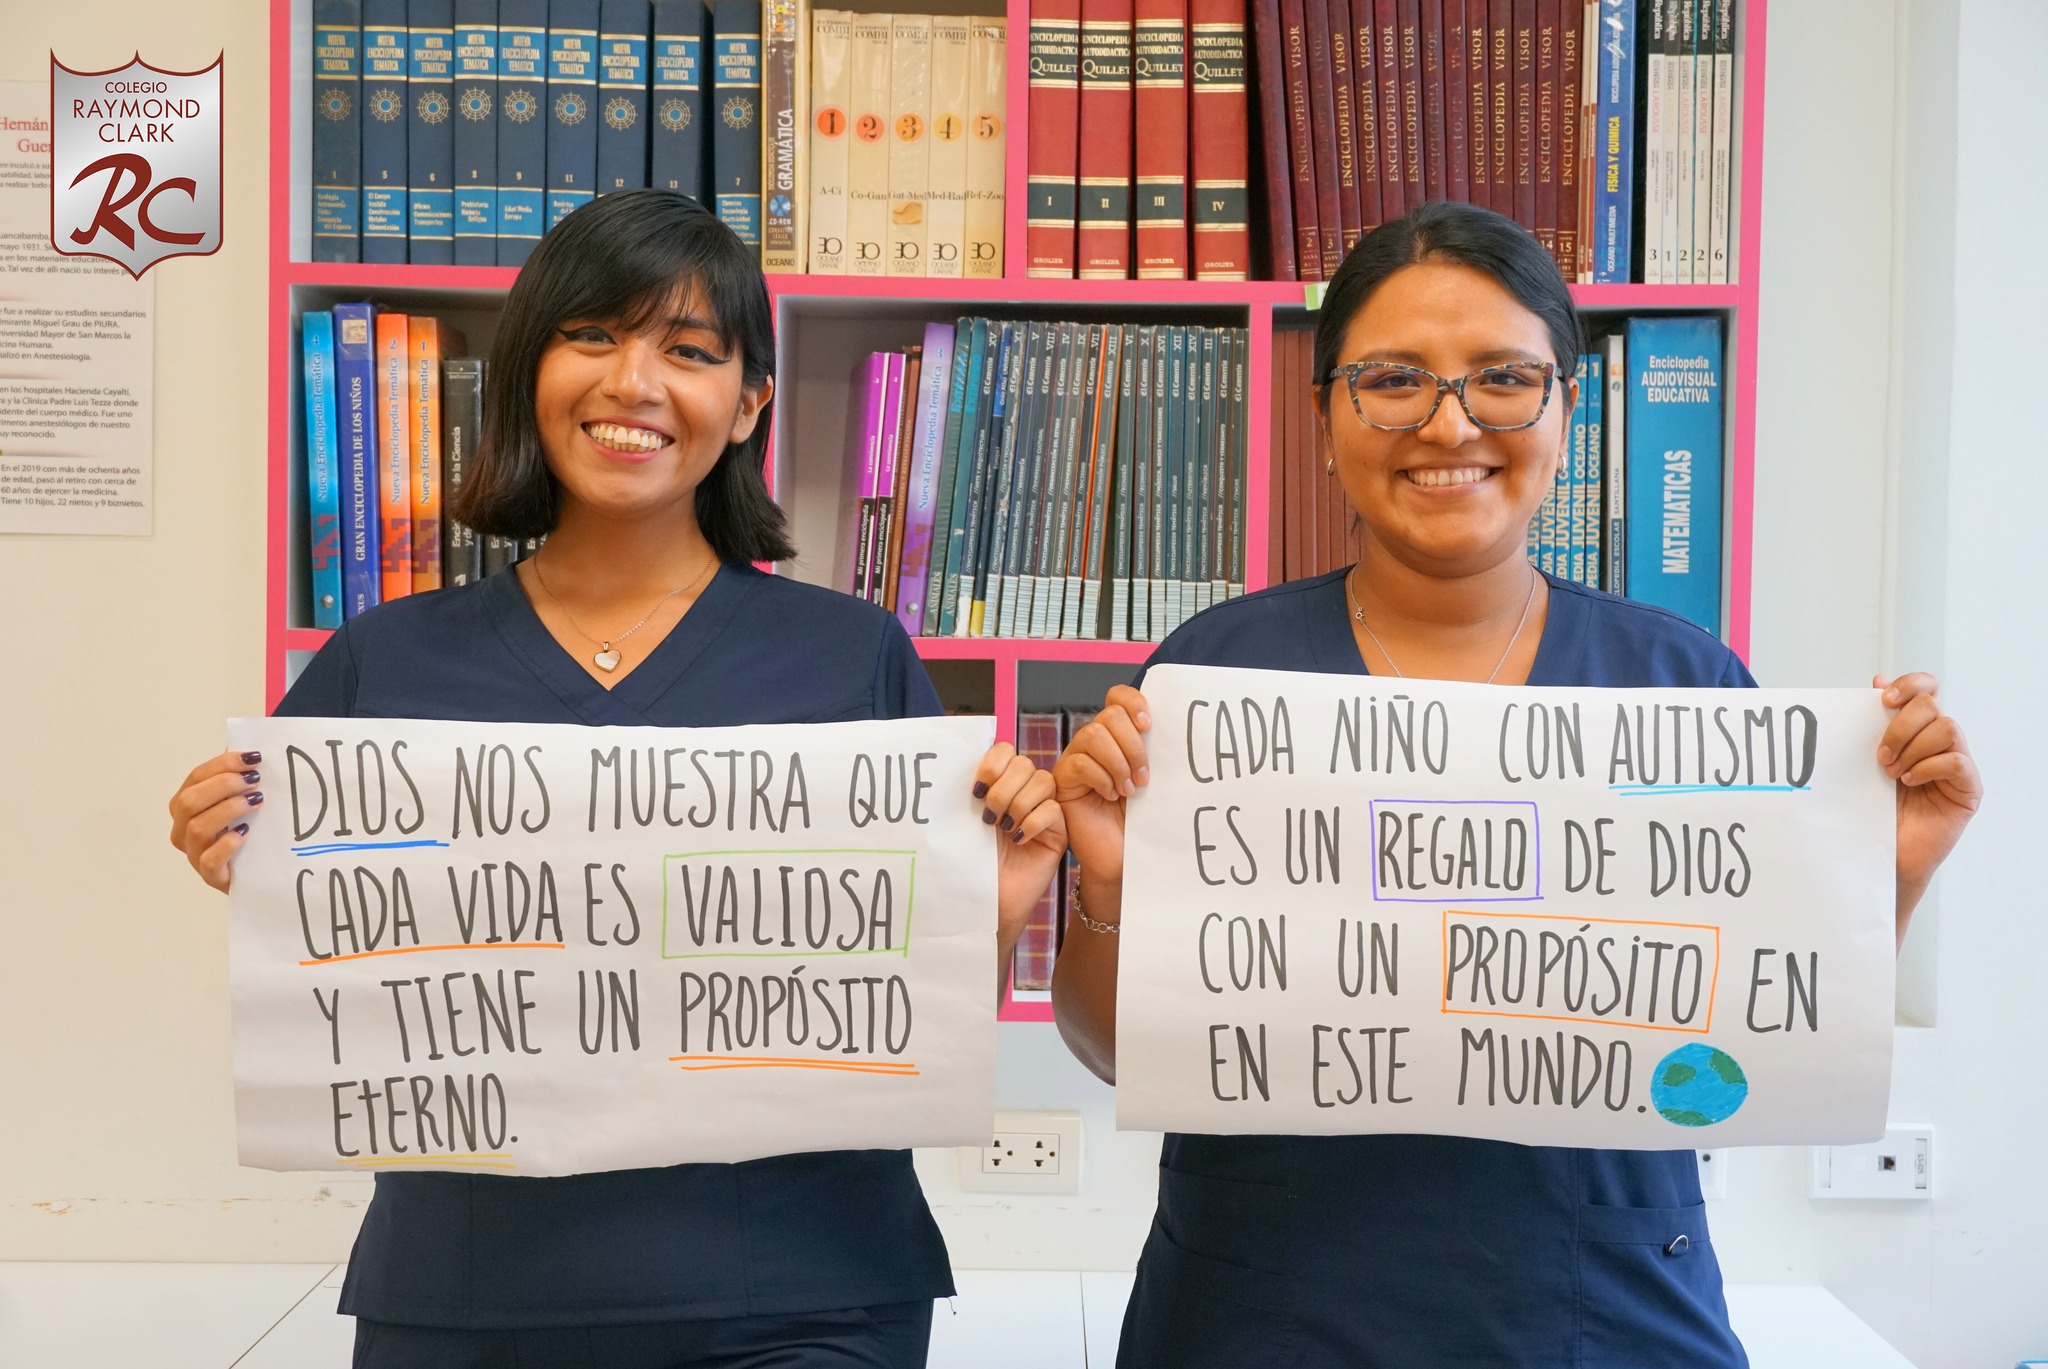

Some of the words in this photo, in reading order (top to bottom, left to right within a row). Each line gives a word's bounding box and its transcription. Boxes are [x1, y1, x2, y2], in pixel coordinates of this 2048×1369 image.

[378, 36, 396, 46] NUEVA
[468, 34, 485, 45] NUEVA
[855, 30, 888, 39] COMBI
[934, 30, 966, 40] COMBI
[1031, 33, 1078, 42] ENCICLOPEDIA
[564, 39, 581, 49] NUEVA
[1194, 38, 1242, 47] ENCICLOPEDIA
[1384, 26, 1394, 68] VISOR
[1194, 50, 1243, 59] AUTODIDACTICA
[1565, 30, 1575, 72] VISOR
[827, 112, 836, 134] 1
[863, 116, 877, 139] 2
[902, 117, 917, 138] 3
[939, 117, 952, 139] 4
[980, 116, 994, 138] 5
[1386, 80, 1398, 182] ENCICLOPEDIA
[1563, 82, 1574, 186] ENCICLOPEDIA
[1608, 116, 1620, 154] QUIMICA
[778, 109, 793, 190] GRAMÁTICA
[333, 171, 337, 179] 1
[382, 171, 388, 179] 5
[430, 173, 435, 181] 6
[472, 170, 477, 178] 8
[516, 172, 522, 180] 9
[565, 174, 573, 182] 11
[1607, 164, 1619, 192] FISICA
[615, 179, 624, 187] 12
[669, 180, 678, 188] 13
[736, 178, 740, 186] 7
[1102, 198, 1109, 208] II
[1154, 196, 1164, 206] III
[1212, 202, 1224, 211] IV
[1560, 242, 1572, 253] 15
[1650, 250, 1657, 260] 3
[1697, 250, 1704, 260] 2
[1715, 250, 1722, 260] 6
[767, 258, 794, 266] OCEANO
[1666, 251, 1670, 261] 1
[1680, 250, 1687, 261] 2
[25, 308, 52, 316] realizar
[65, 309, 98, 317] estudios
[100, 310, 146, 318] secundarios
[390, 340, 396, 349] 2
[422, 341, 426, 350] 1
[989, 333, 997, 347] XV
[1126, 335, 1134, 345] VI
[1158, 335, 1166, 352] XVI
[936, 348, 943, 358] 3
[1592, 362, 1599, 377] 1
[1650, 355, 1708, 371] Enciclopedia
[388, 358, 398, 402] Temática
[419, 359, 428, 403] Temática
[1641, 372, 1716, 386] AUDIOVISUAL
[350, 377, 362, 410] NIÑOS
[929, 366, 942, 409] Temática
[1648, 388, 1710, 403] EDUCATIVA
[353, 413, 362, 433] LOS
[353, 434, 363, 449] DE
[389, 404, 401, 468] Enciclopedia
[419, 406, 431, 470] Enciclopedia
[923, 412, 937, 478] Enciclopedia
[1588, 423, 1600, 479] OCEANO
[88, 466, 120, 474] ochenta
[354, 452, 365, 528] ENCICLOPEDIA
[392, 472, 400, 503] Nueva
[421, 473, 429, 504] Nueva
[919, 479, 930, 509] Nueva
[70, 499, 93, 507] nietos
[1586, 481, 1600, 548] JUVENIL
[1662, 450, 1692, 574] MATEMATICAS
[860, 505, 869, 539] enciclopedia
[356, 532, 365, 560] GRAN
[858, 566, 863, 575] Mi
[1187, 696, 1294, 783] CADA
[1500, 702, 1585, 783] CON
[1609, 703, 1818, 788] AUTISMO
[286, 740, 425, 841] DIOS
[452, 744, 550, 839] NOS
[589, 746, 810, 833] MUESTRA
[849, 752, 937, 828] QUE
[1194, 805, 1257, 885] ES
[1286, 806, 1340, 885] UN
[1379, 811, 1527, 890] REGALO
[1564, 818, 1616, 895] DE
[1649, 820, 1751, 898] DIOS
[296, 866, 420, 959] CADA
[447, 861, 563, 944] VIDA
[584, 863, 640, 946] ES
[681, 864, 892, 951] VALIOSA
[1199, 912, 1286, 993] CON
[1338, 918, 1398, 997] UN
[1746, 948, 1818, 1033] EN
[313, 988, 341, 1065] Y
[381, 969, 542, 1063] TIENE
[579, 968, 640, 1055] UN
[680, 965, 912, 1055] PROPÓSITO
[1209, 1024, 1270, 1102] EN
[1312, 1024, 1413, 1107] ESTE
[1458, 1028, 1646, 1114] MUNDO.
